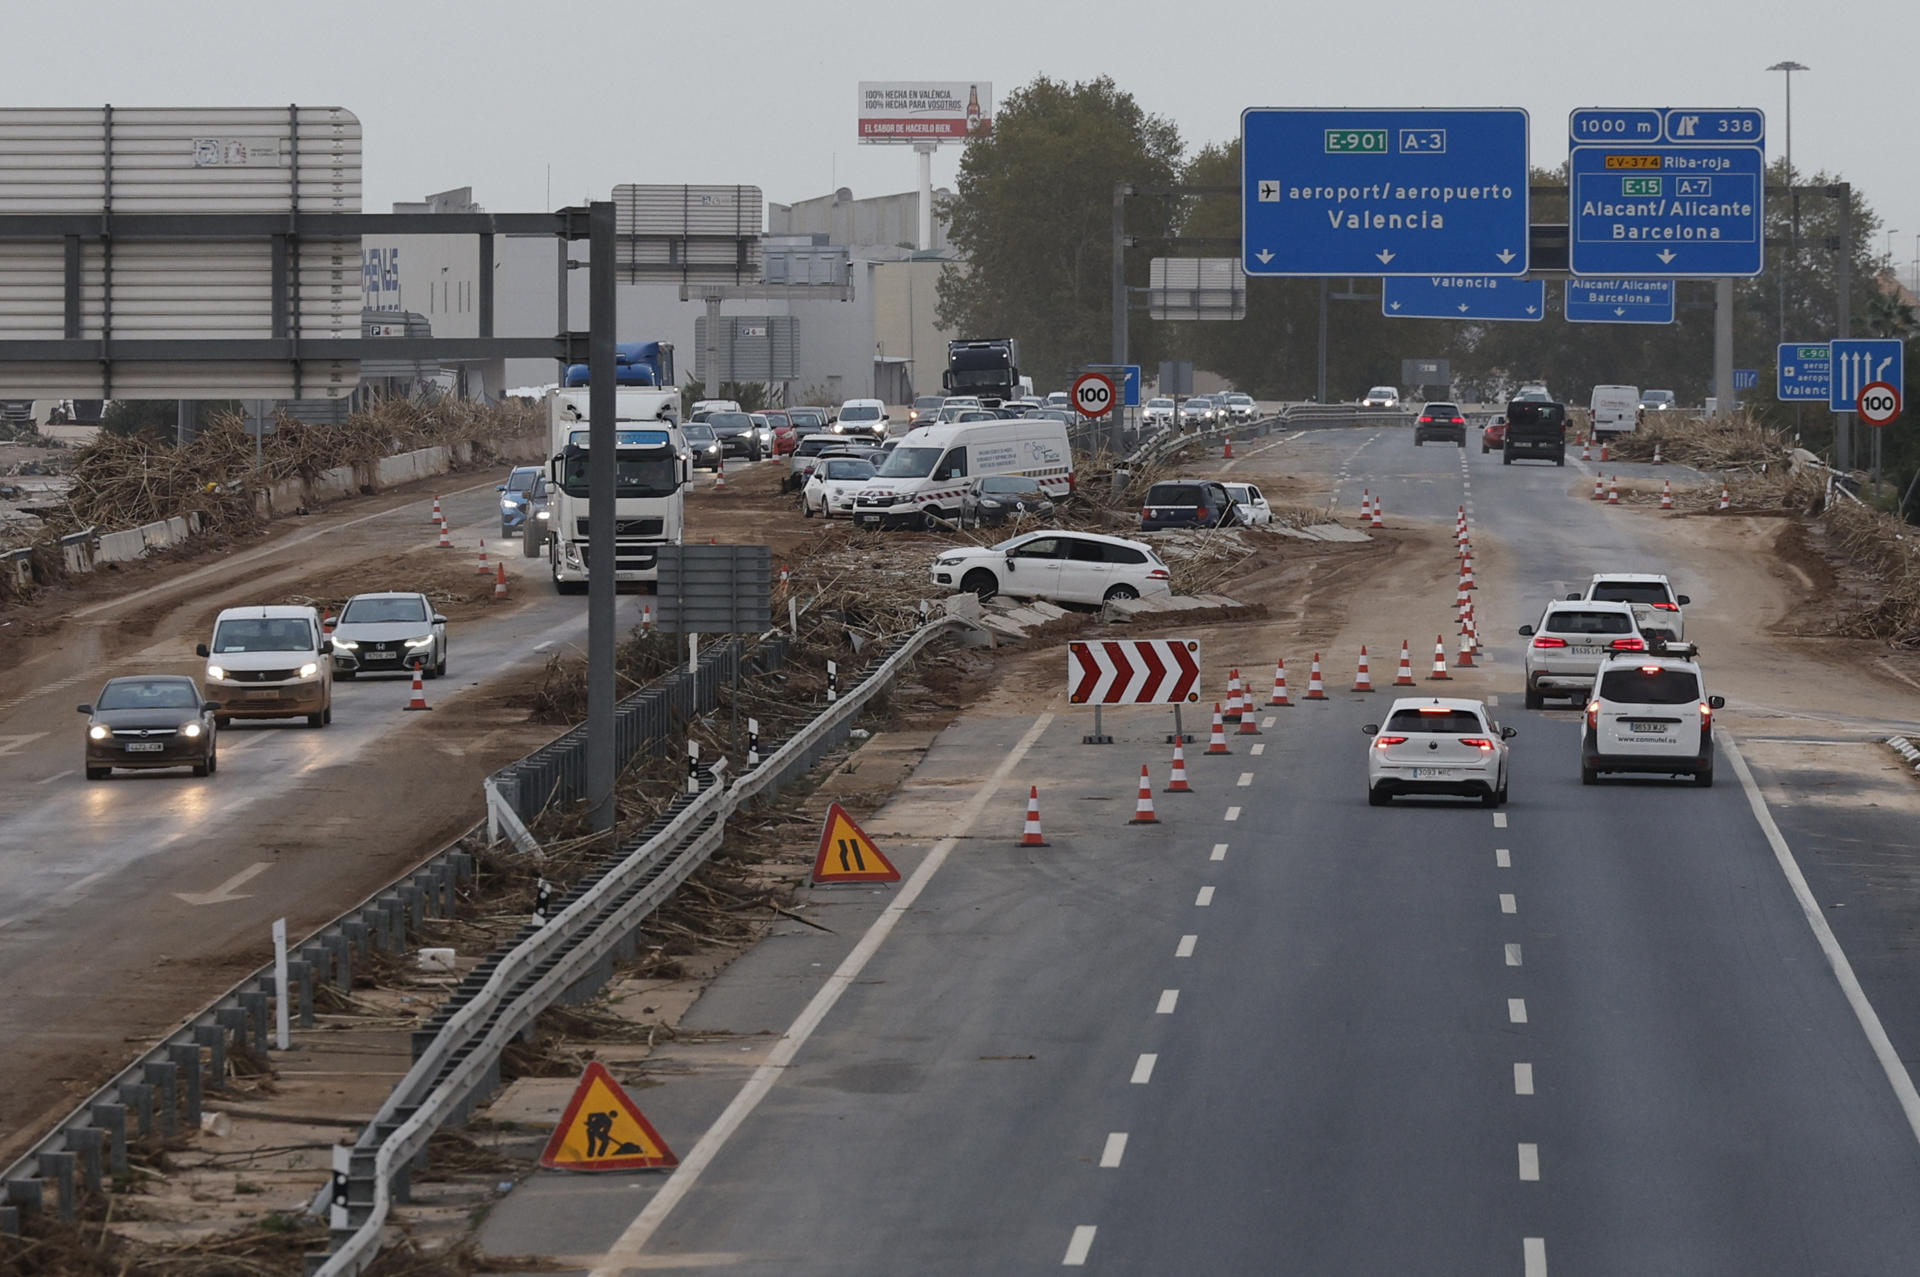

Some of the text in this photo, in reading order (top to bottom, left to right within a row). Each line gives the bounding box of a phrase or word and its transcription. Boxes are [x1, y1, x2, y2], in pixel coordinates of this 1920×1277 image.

[865, 91, 884, 99] 100%
[886, 91, 907, 99] HECHA
[909, 90, 918, 98] EN
[865, 101, 884, 109] 100%
[886, 101, 907, 109] HECHA
[909, 100, 926, 108] PARA
[865, 125, 872, 133] EL
[906, 124, 934, 132] HACERLO
[1582, 120, 1651, 133] 1000 m
[1718, 120, 1753, 132] 338
[1329, 134, 1442, 148] E-901 A-3
[1607, 157, 1730, 170] CV-374 Riba-roja
[1626, 181, 1707, 193] E-15 A-7
[1328, 210, 1444, 229] Valencia
[1613, 224, 1720, 238] Barcelona
[1432, 276, 1496, 288] Valencia
[1589, 293, 1650, 303] Barcelona
[1079, 388, 1108, 402] 100
[1785, 386, 1826, 395] Valenc
[1864, 397, 1893, 410] 100
